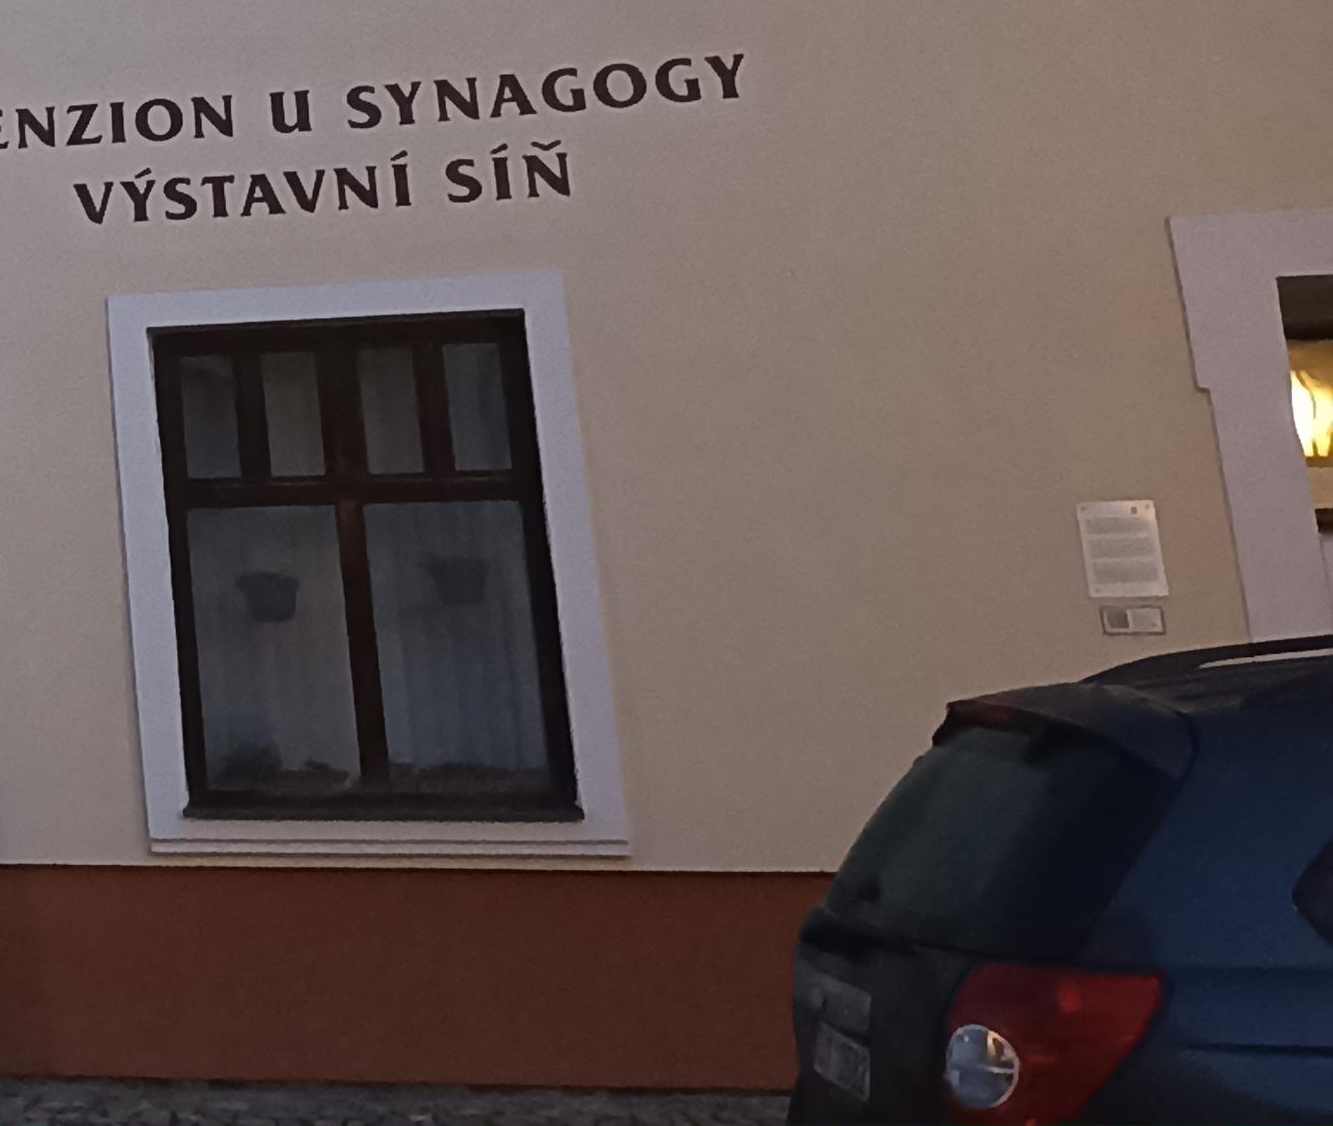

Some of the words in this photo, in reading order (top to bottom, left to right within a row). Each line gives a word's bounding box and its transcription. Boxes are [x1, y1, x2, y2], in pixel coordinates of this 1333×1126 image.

[269, 89, 313, 134] U
[346, 53, 745, 129] SYNAGOGY
[73, 149, 412, 225] VÝSTAVNÍ
[445, 139, 571, 204] SÍŇ
